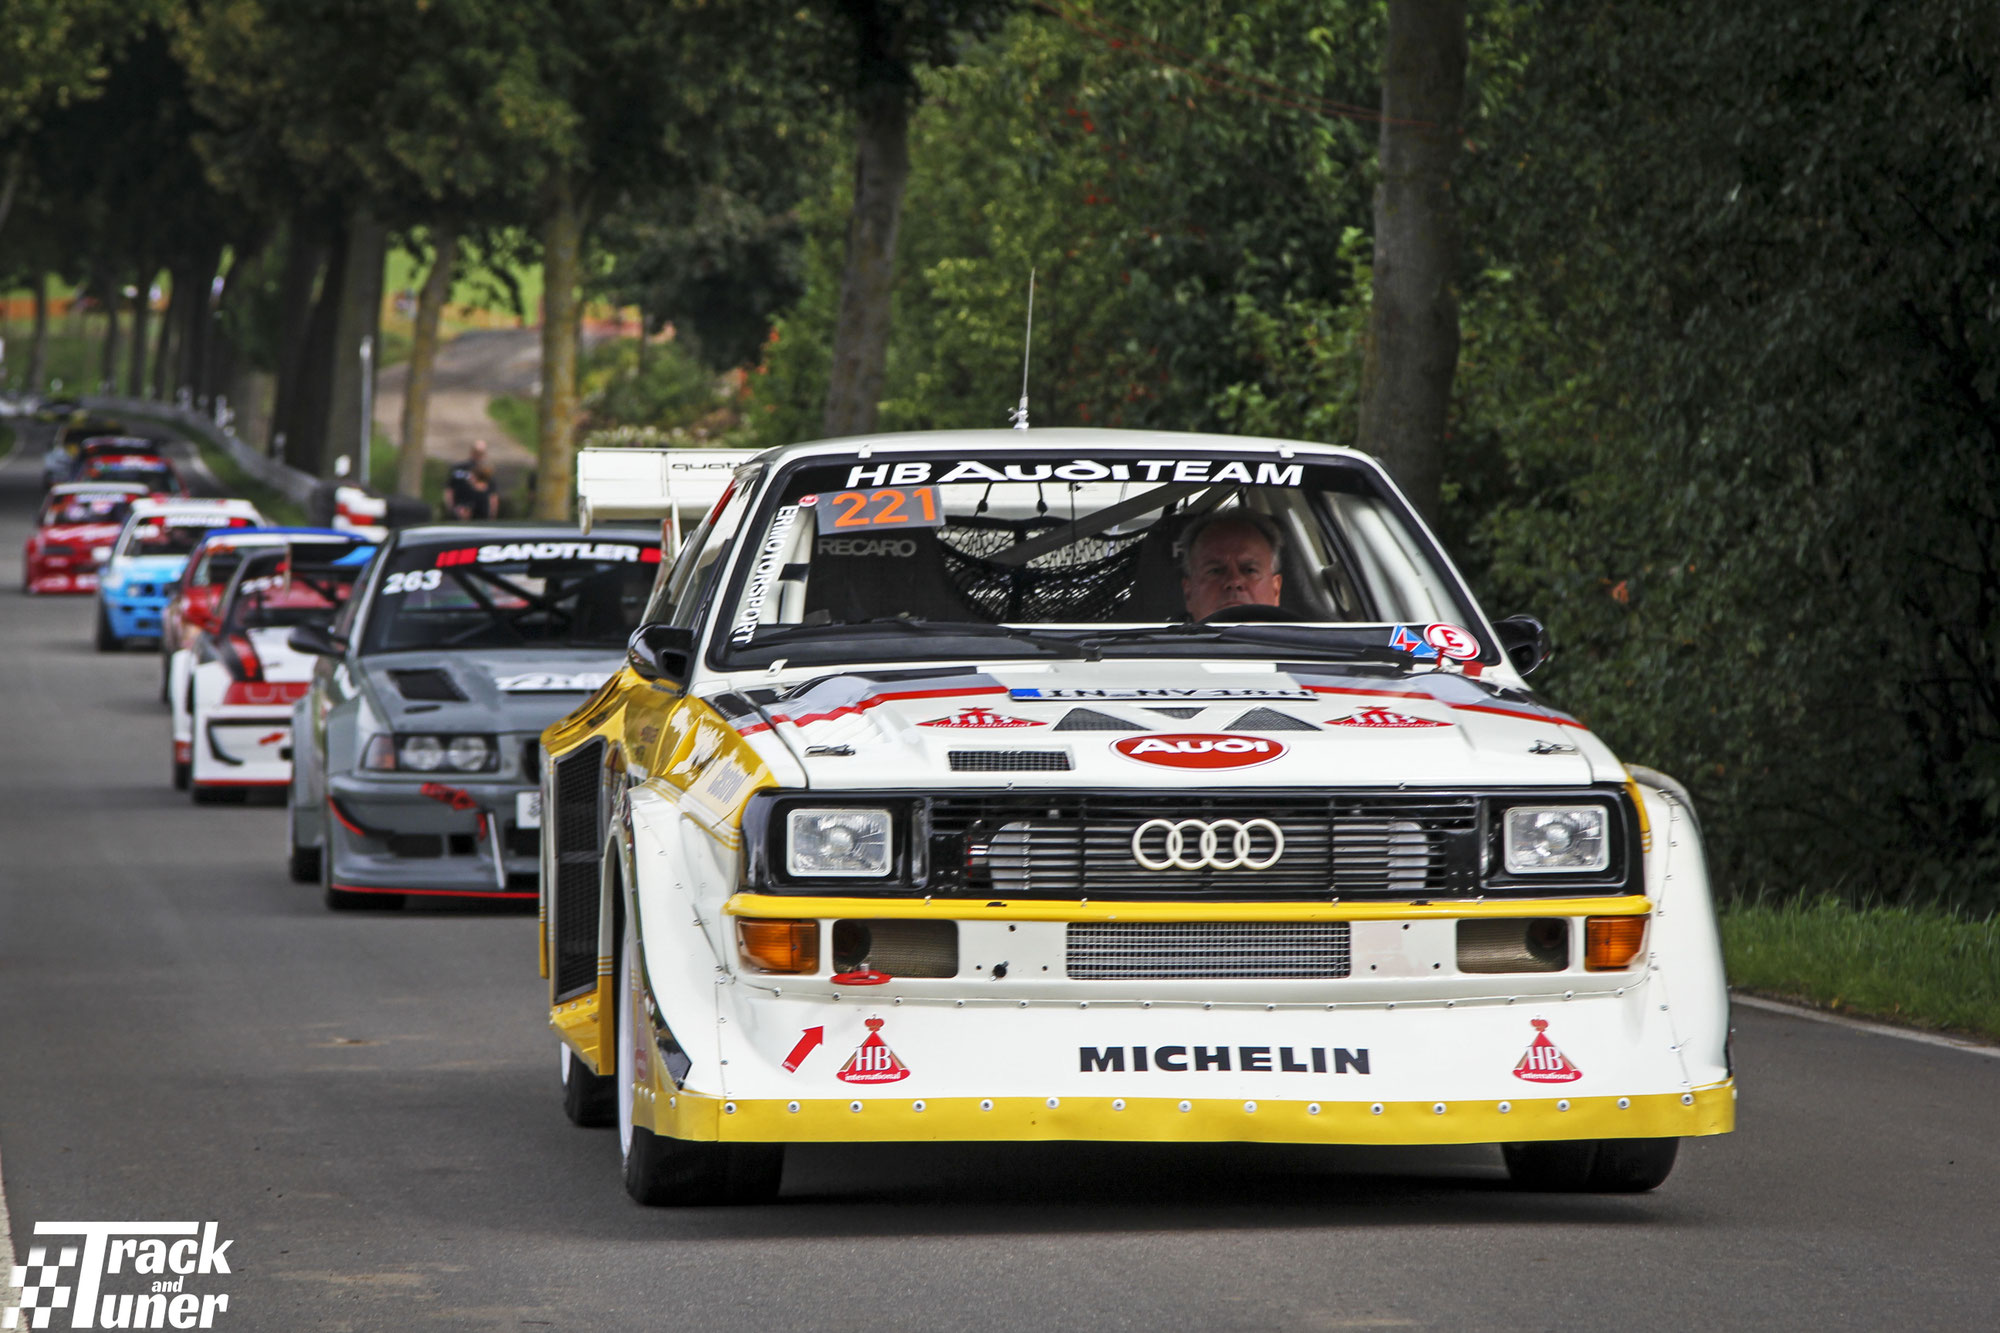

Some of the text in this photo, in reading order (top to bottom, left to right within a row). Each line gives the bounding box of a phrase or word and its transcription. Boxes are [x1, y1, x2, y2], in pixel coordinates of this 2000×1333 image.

[845, 462, 931, 488] HB
[1137, 460, 1305, 487] TEAM
[832, 487, 937, 528] 221
[476, 543, 640, 564] SANDTLER
[817, 539, 917, 557] RECARO
[381, 569, 443, 595] 263
[1129, 738, 1269, 754] Audi
[854, 1046, 893, 1071] HB
[1079, 1046, 1371, 1075] MICHELIN
[1526, 1045, 1565, 1070] HB
